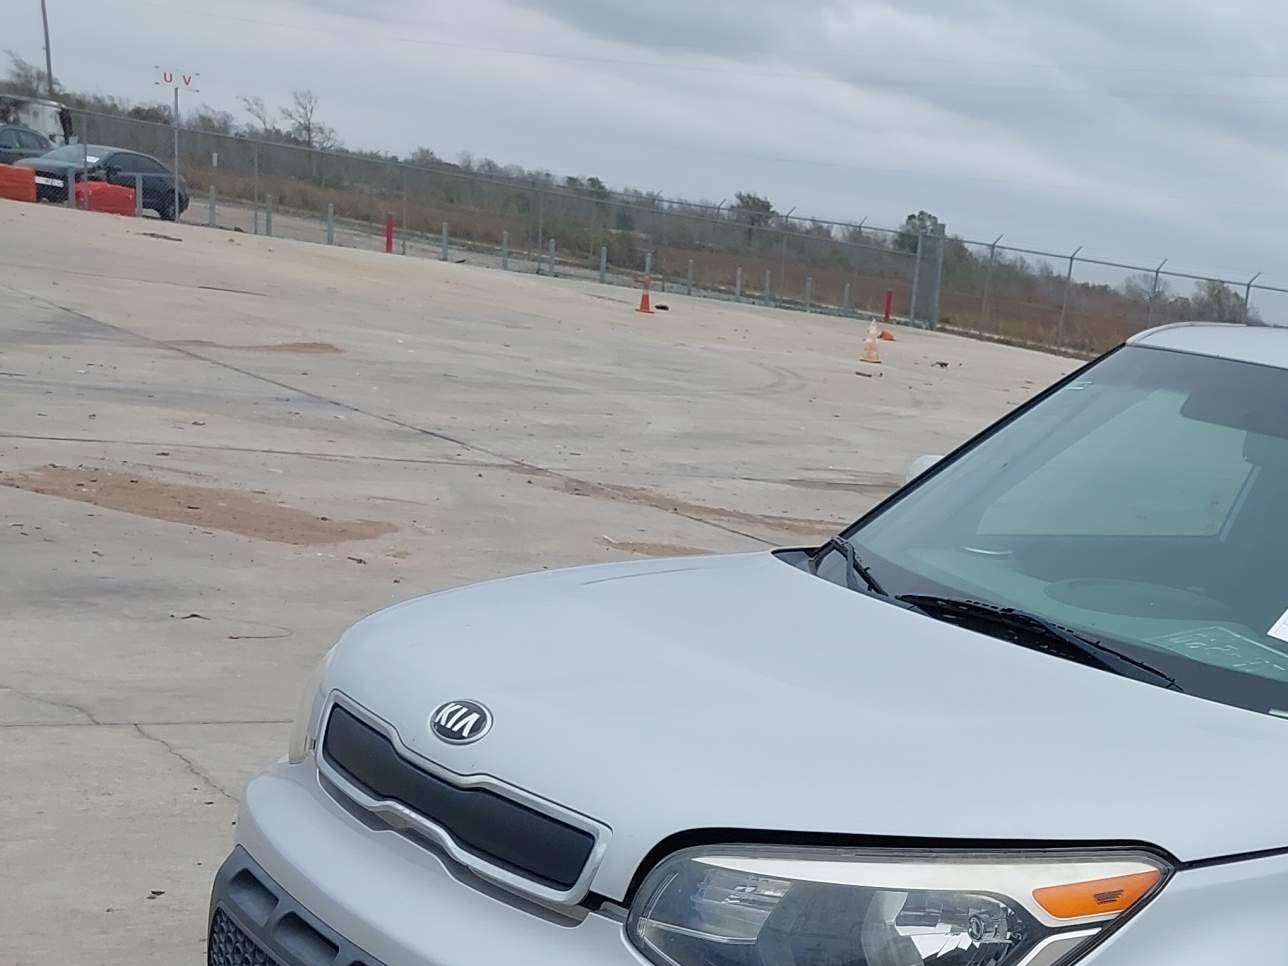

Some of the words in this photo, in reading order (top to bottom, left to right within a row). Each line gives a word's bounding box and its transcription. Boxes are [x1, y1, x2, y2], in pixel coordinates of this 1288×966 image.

[163, 71, 173, 83] U
[182, 75, 192, 86] V
[434, 702, 481, 738] KIA
